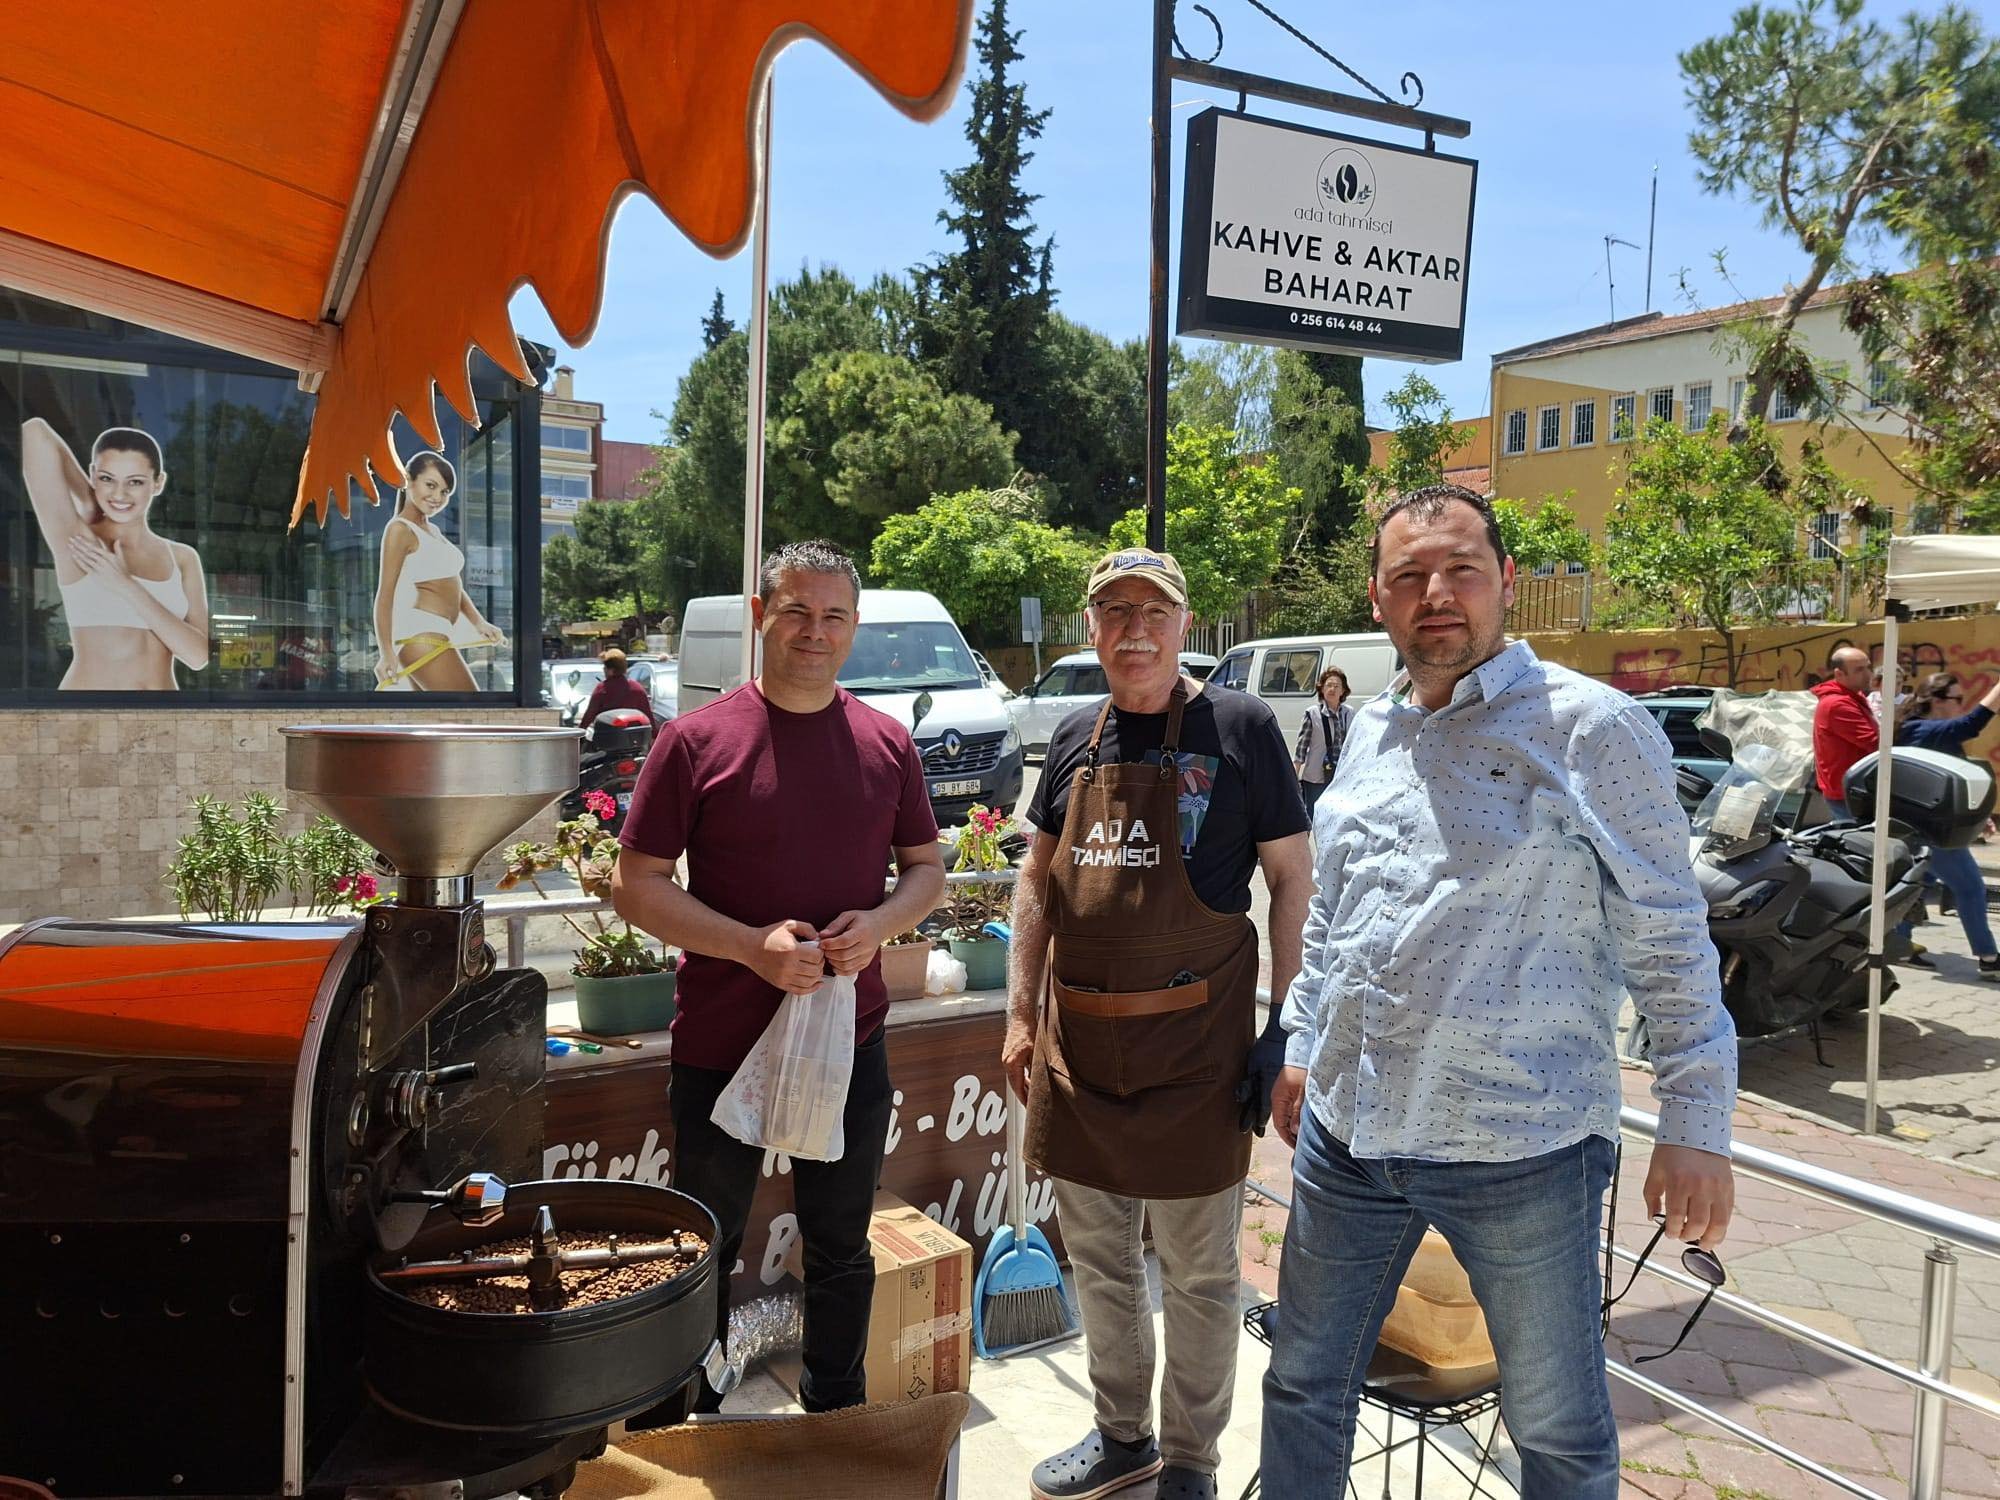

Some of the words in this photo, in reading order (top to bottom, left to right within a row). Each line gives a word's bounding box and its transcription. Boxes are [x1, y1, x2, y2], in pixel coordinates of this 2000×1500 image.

[1294, 206, 1323, 223] ada
[1328, 210, 1393, 235] tahmisçi
[1213, 220, 1322, 262] KAHVE
[1334, 241, 1353, 266] &
[1363, 245, 1461, 282] AKTAR
[1264, 268, 1413, 312] BAHARAT
[1290, 312, 1298, 324] 0
[1301, 314, 1322, 327] 256
[1325, 316, 1345, 330] 614
[1348, 319, 1363, 332] 48
[1366, 321, 1382, 334] 44
[1085, 819, 1150, 844] ADA
